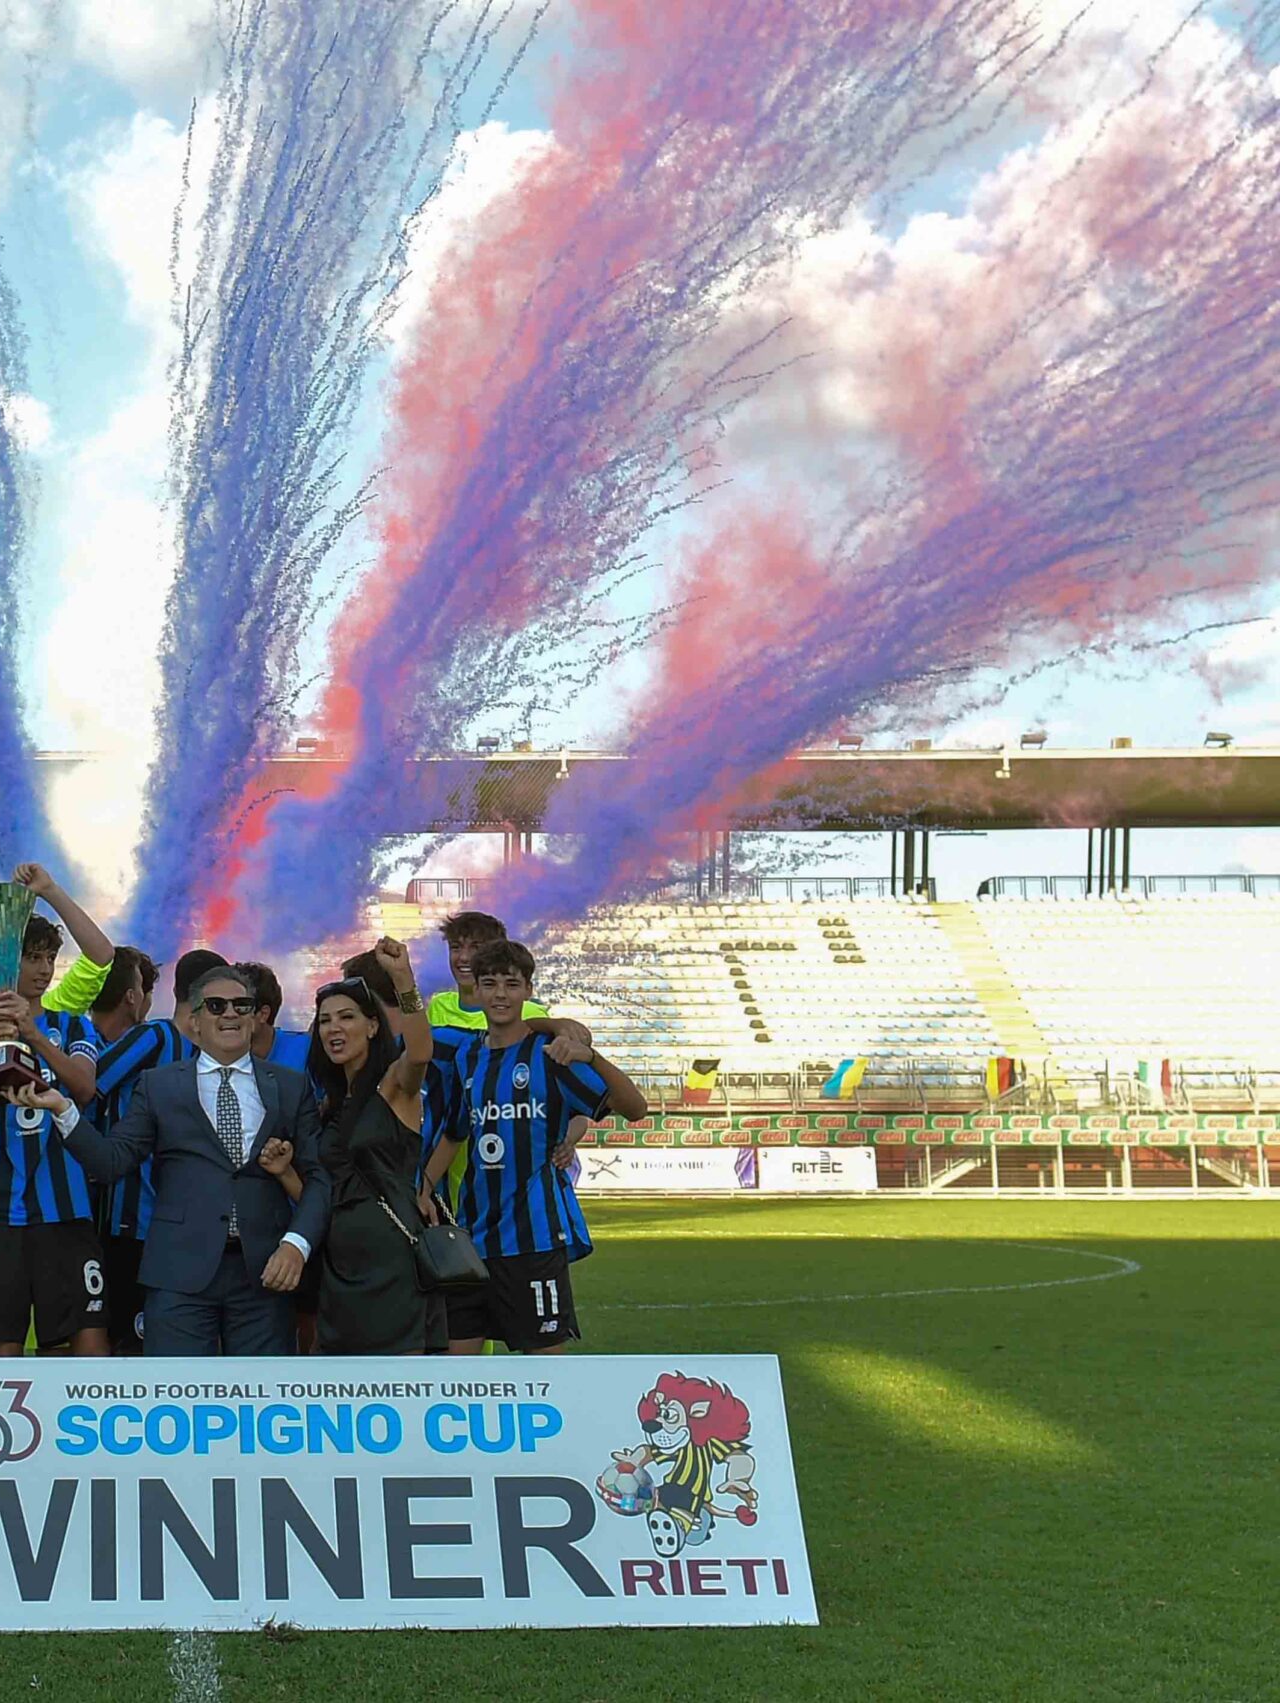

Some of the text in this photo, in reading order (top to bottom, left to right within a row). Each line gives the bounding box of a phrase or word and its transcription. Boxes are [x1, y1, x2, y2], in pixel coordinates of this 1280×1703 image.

[471, 1098, 547, 1125] sybank
[83, 1260, 104, 1295] 6
[530, 1280, 559, 1317] 11
[65, 1382, 551, 1399] WORLD FOOTBALL TOURNAMENT UNDER 17
[55, 1402, 563, 1456] SCOPIGNO CUP
[620, 1559, 789, 1596] RIETI
